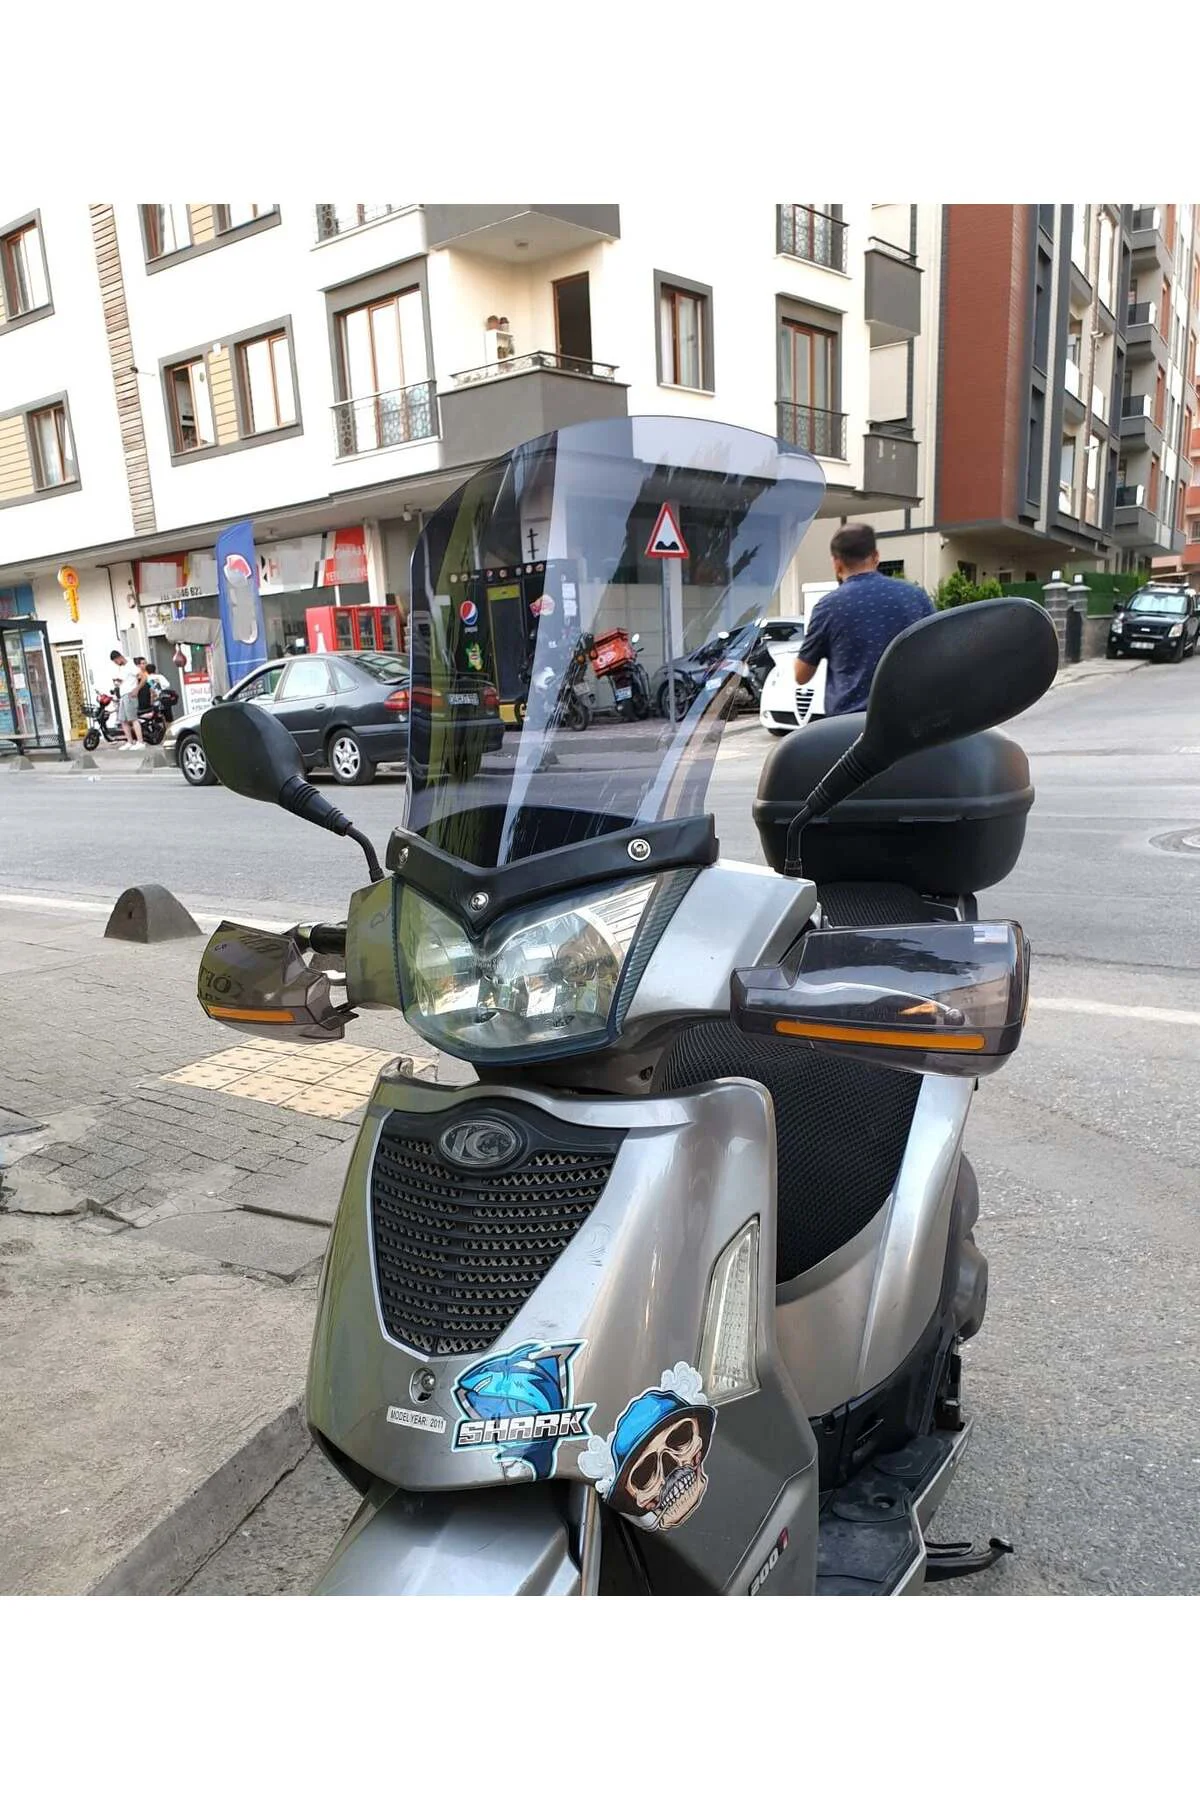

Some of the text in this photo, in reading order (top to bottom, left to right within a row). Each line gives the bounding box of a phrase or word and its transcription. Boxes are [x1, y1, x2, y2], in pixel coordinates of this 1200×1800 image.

[391, 1409, 409, 1422] MODEL
[430, 1418, 444, 1429] 2011
[459, 1411, 586, 1444] SHARK
